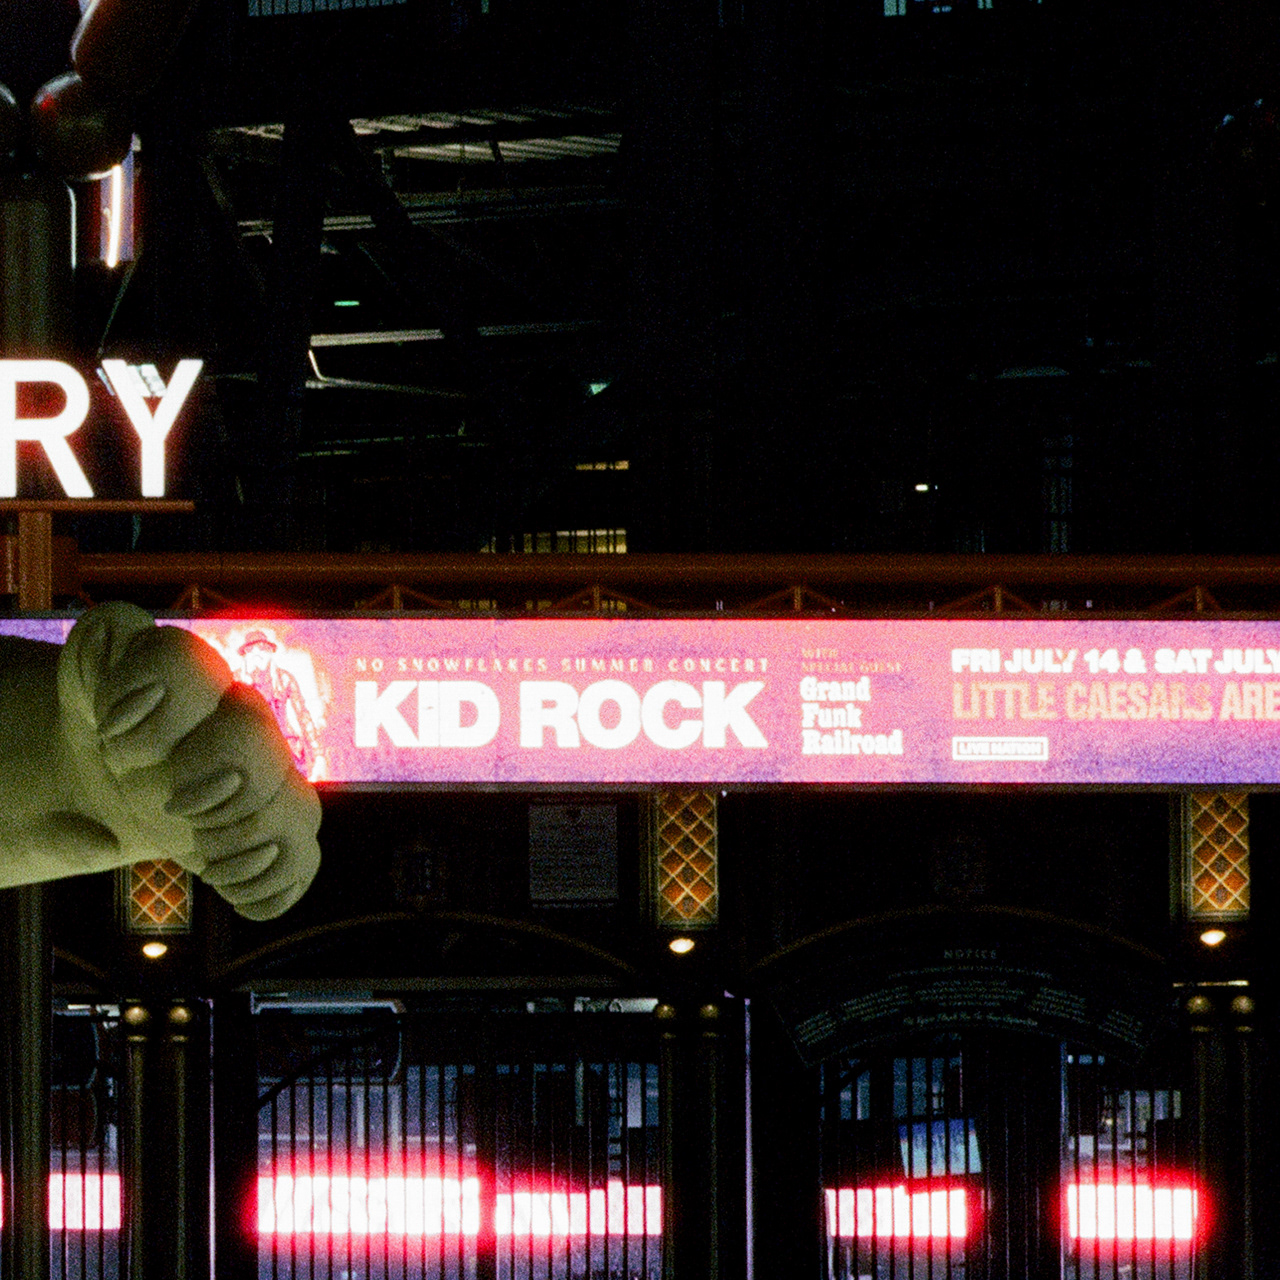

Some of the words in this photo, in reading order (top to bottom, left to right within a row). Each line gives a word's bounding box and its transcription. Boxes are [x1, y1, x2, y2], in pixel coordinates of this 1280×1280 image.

[356, 657, 383, 672] NO
[397, 657, 547, 672] SNOWFLAKES
[561, 657, 653, 672] SUMMER
[668, 657, 768, 672] CONCERT
[951, 648, 1000, 673] FRI
[1004, 648, 1078, 673] JULY
[1083, 648, 1121, 673] 14
[1123, 648, 1148, 673] &
[1154, 648, 1213, 673] SAT
[800, 676, 871, 702] Grand
[952, 681, 1057, 720] LITTLE
[1065, 681, 1213, 720] CAESARS
[1219, 681, 1280, 720] ARE
[354, 681, 500, 748] KID
[519, 679, 768, 750] ROCK
[801, 703, 862, 728] Funk
[801, 729, 903, 755] Railroad
